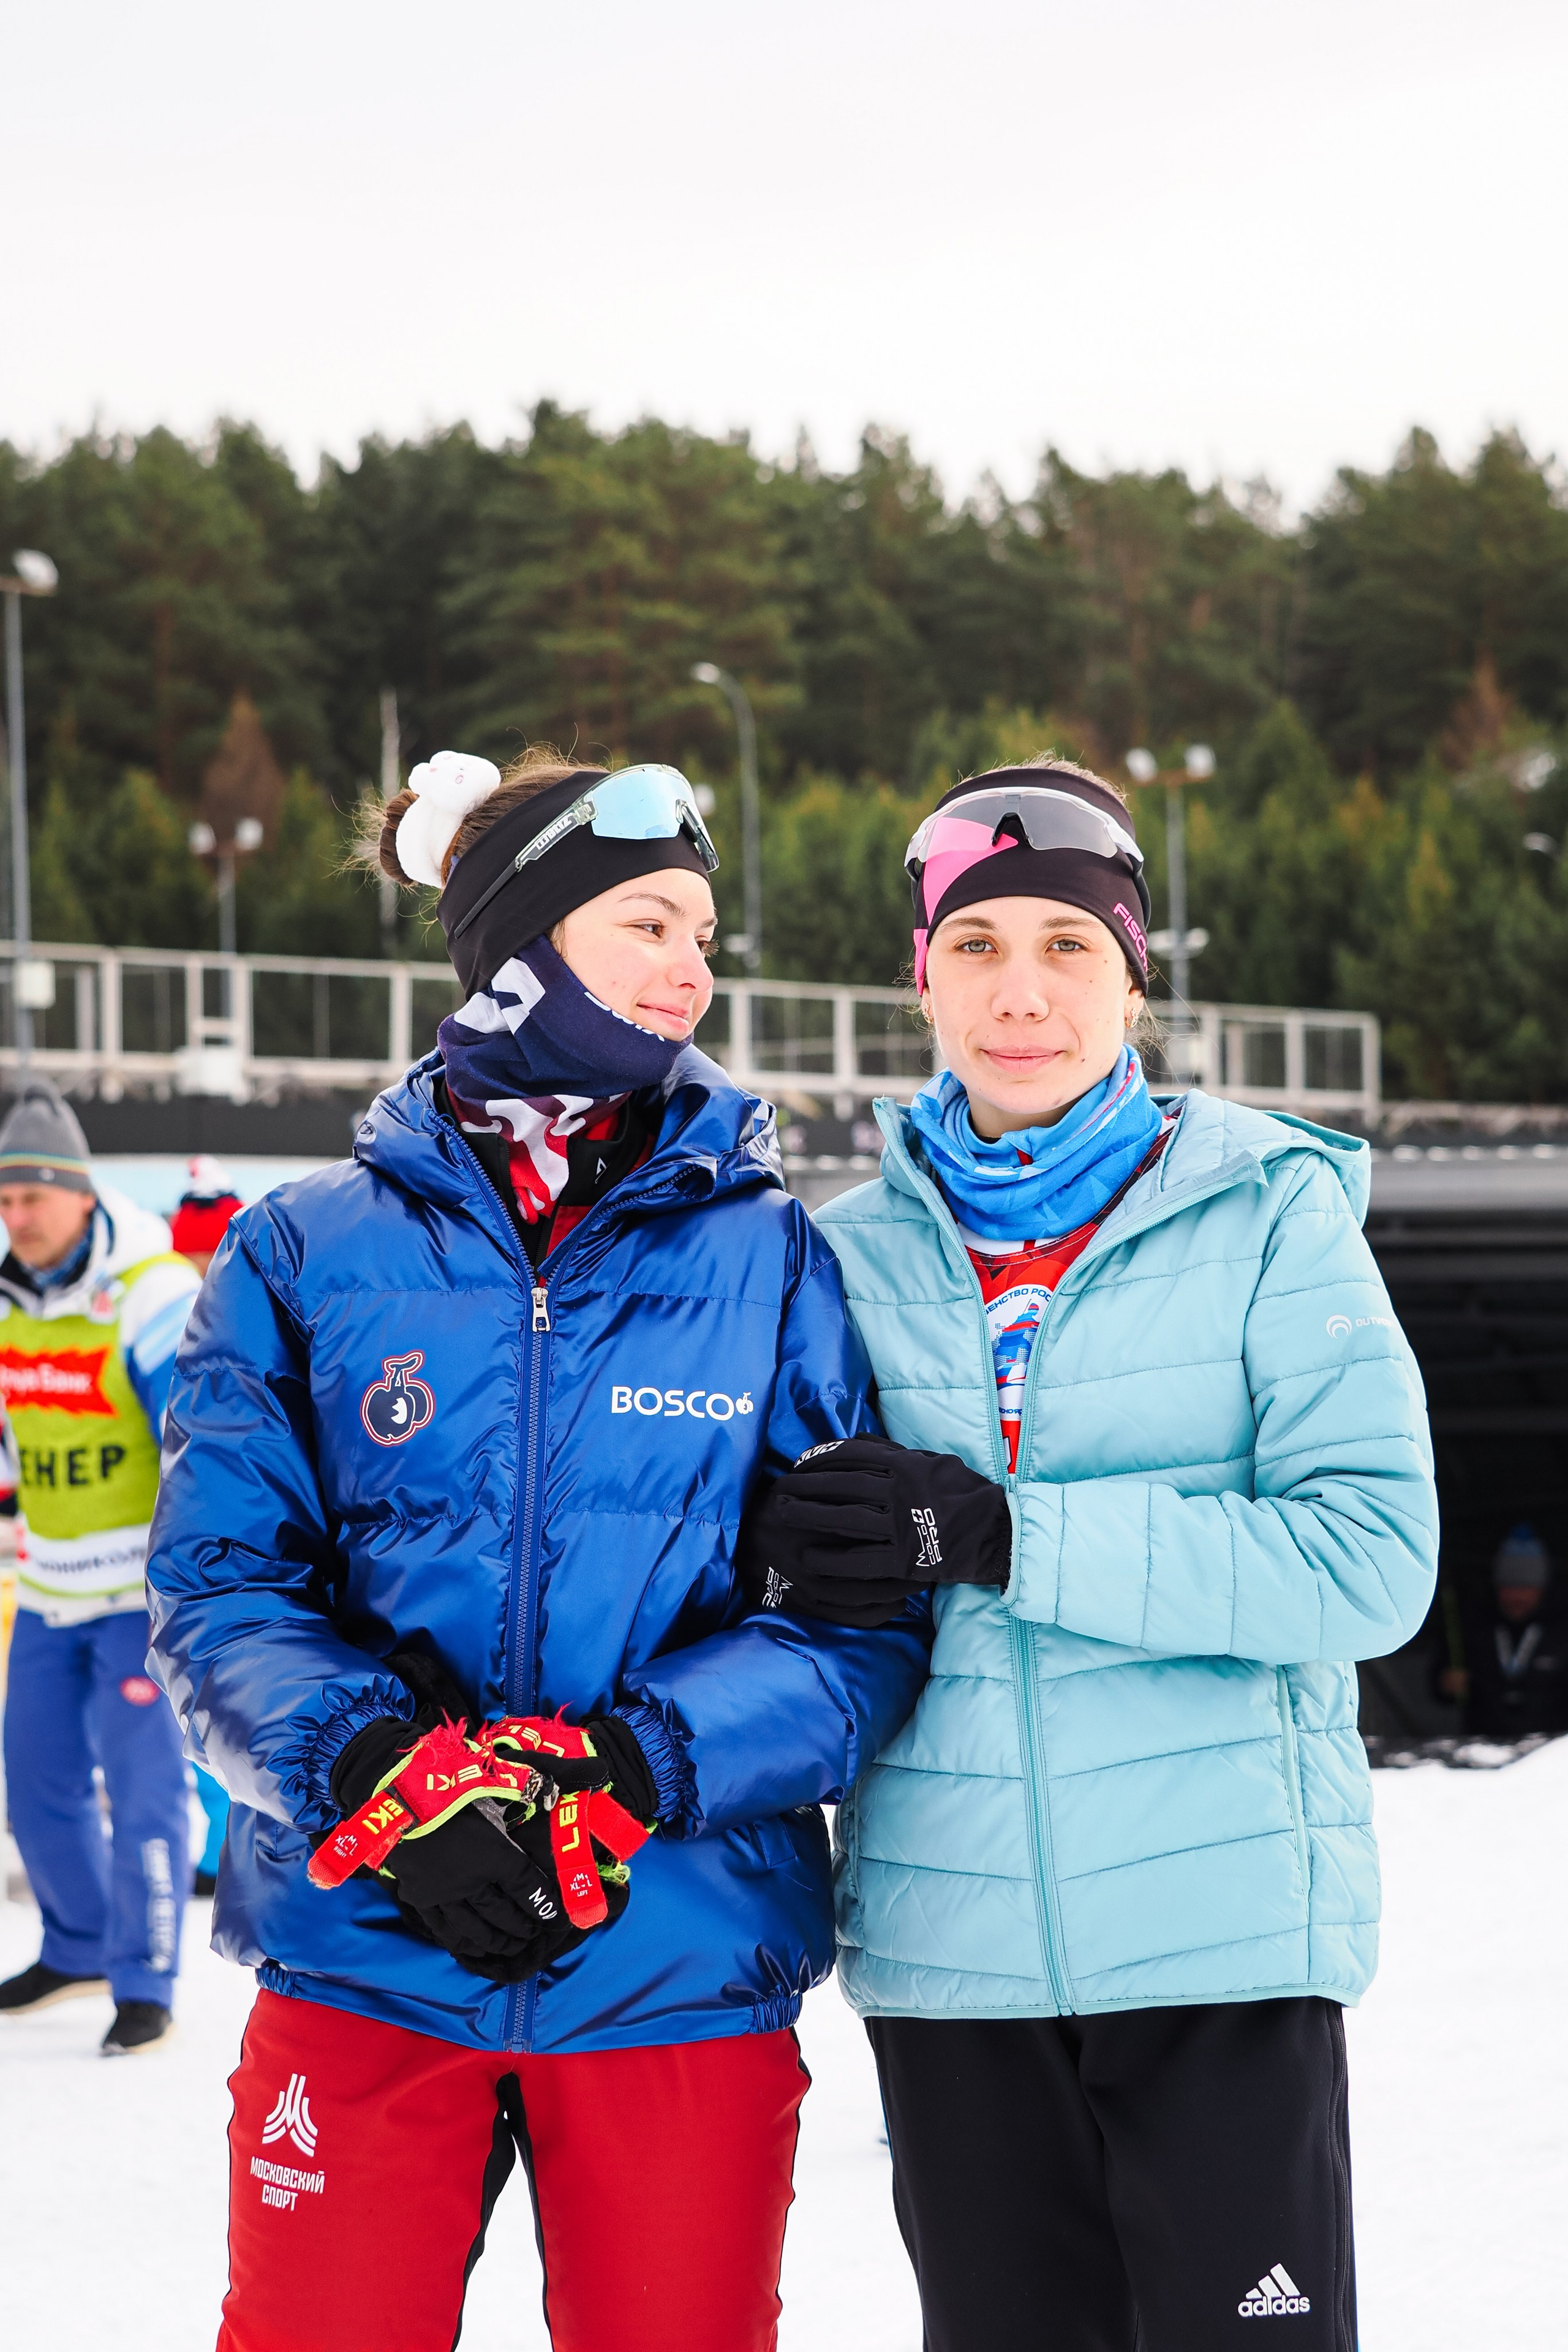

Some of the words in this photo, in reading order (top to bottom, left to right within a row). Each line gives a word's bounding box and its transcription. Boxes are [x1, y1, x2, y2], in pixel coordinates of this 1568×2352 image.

[611, 1386, 734, 1420] BOSCO
[924, 1508, 943, 1562] PRO
[362, 1798, 404, 1835] EKI
[559, 1791, 580, 1852] LEK
[570, 1882, 580, 1891] XL
[251, 2156, 325, 2194] МОСКОВСКИЙ
[262, 2184, 298, 2211] СПОРТ
[1238, 2295, 1310, 2317] adidas
